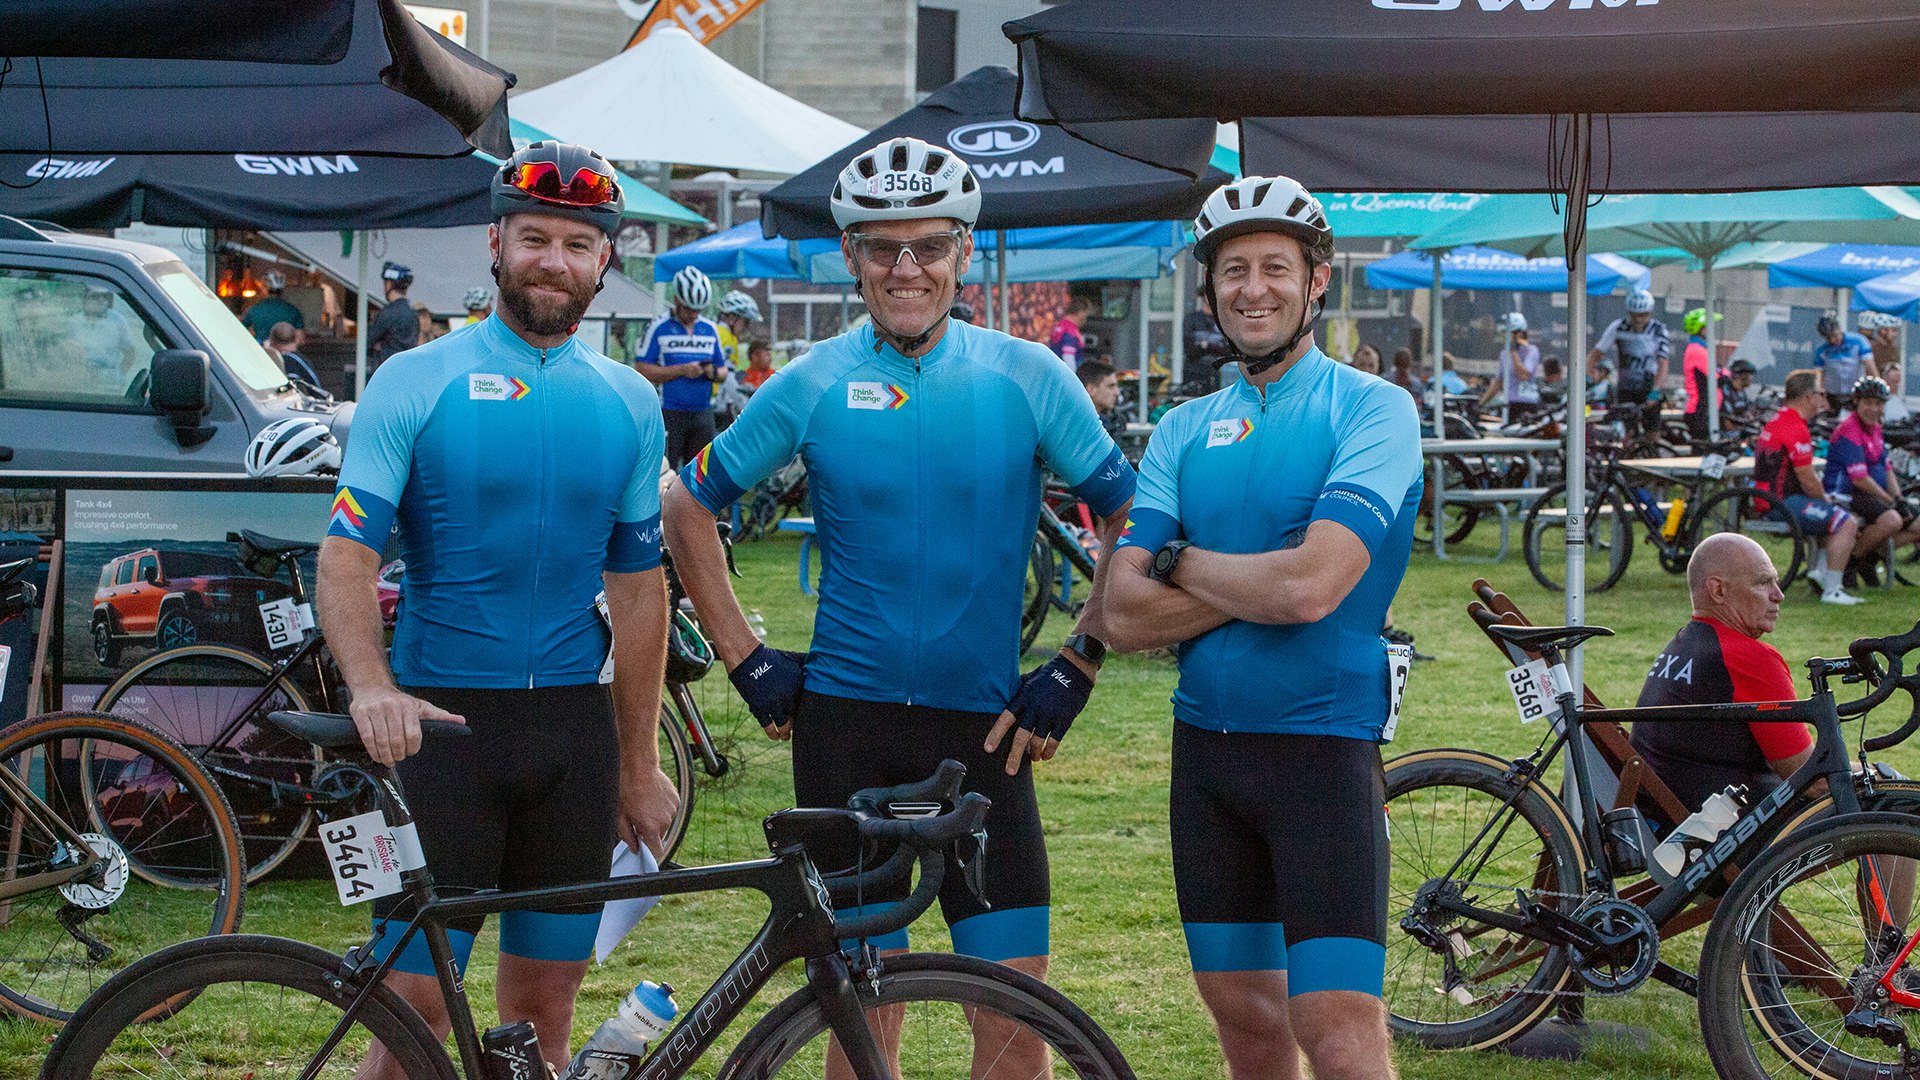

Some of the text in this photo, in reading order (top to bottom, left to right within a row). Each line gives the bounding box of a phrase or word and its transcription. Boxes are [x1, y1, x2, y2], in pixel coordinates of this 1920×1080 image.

[26, 157, 116, 178] GWM
[234, 154, 359, 175] GWM
[969, 156, 1065, 178] WM
[884, 173, 933, 193] 3568
[668, 340, 713, 349] GIANT
[474, 386, 503, 394] Change
[852, 388, 874, 396] Think
[852, 395, 881, 404] Change
[75, 500, 112, 508] Tank 4x4
[1329, 494, 1359, 506] COUNCIL
[1332, 489, 1372, 508] Sunshine
[74, 511, 117, 520] Impressive
[74, 521, 178, 530] crushing 4x4 performance
[263, 604, 288, 645] 1430
[1396, 648, 1409, 657] UCI
[1510, 668, 1543, 719] 3568
[130, 696, 146, 704] Ute
[1684, 780, 1796, 893] RIBBLE
[326, 824, 375, 899] 3464
